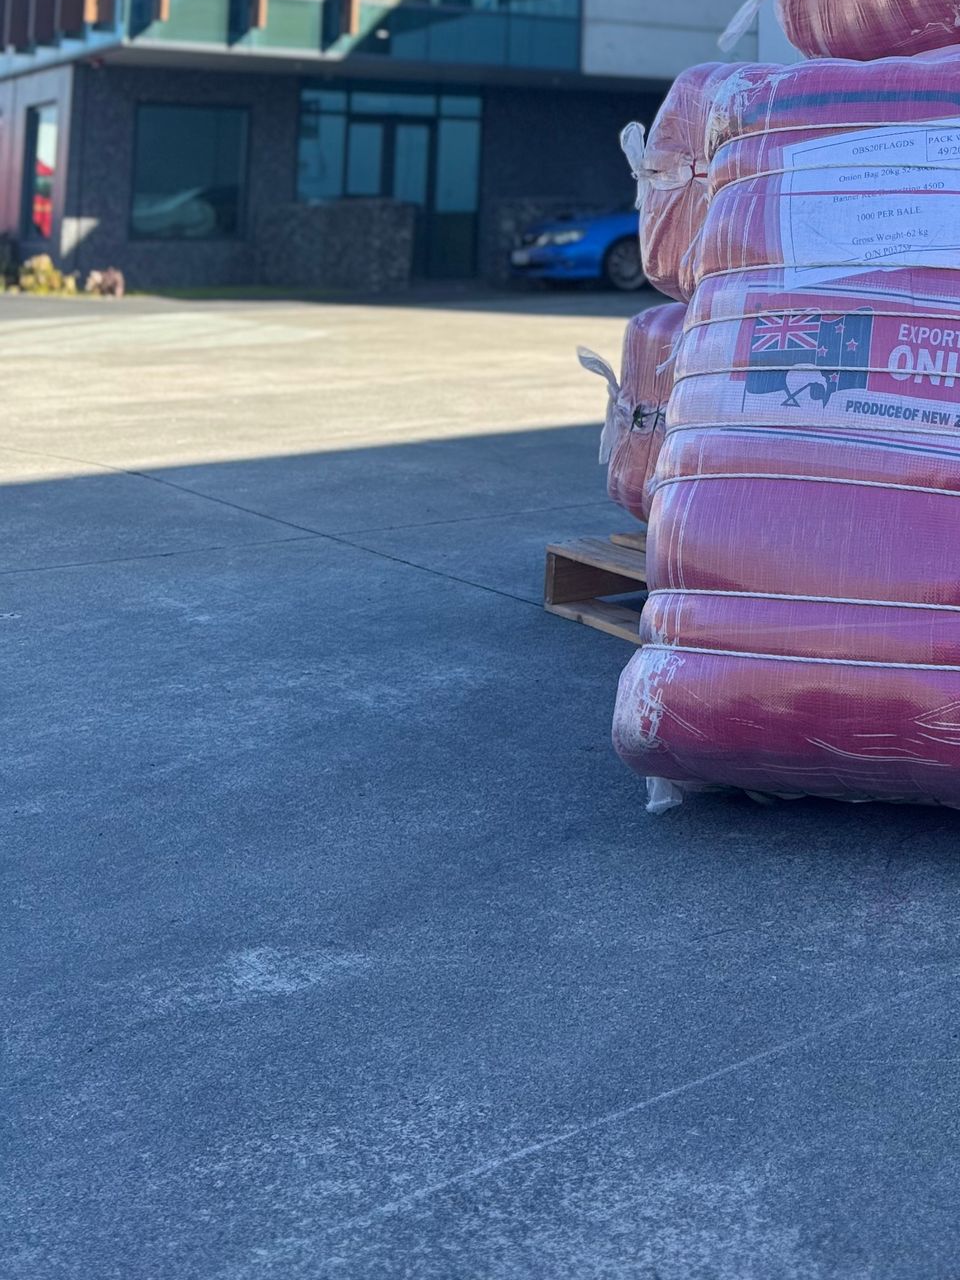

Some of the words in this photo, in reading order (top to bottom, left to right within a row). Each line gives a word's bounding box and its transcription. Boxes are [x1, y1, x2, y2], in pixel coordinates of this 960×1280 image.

[928, 134, 953, 144] PACK
[838, 174, 862, 182] Onion
[864, 171, 879, 180] Bag
[881, 168, 900, 177] 20kg
[923, 181, 945, 190] 450D
[857, 211, 875, 221] 1000
[877, 209, 894, 219] PER
[896, 206, 921, 217] BALE
[851, 236, 874, 245] Gross
[918, 228, 929, 237] kg
[845, 400, 902, 419] PRODUCE
[903, 407, 920, 420] OF
[921, 410, 950, 426] NEW
